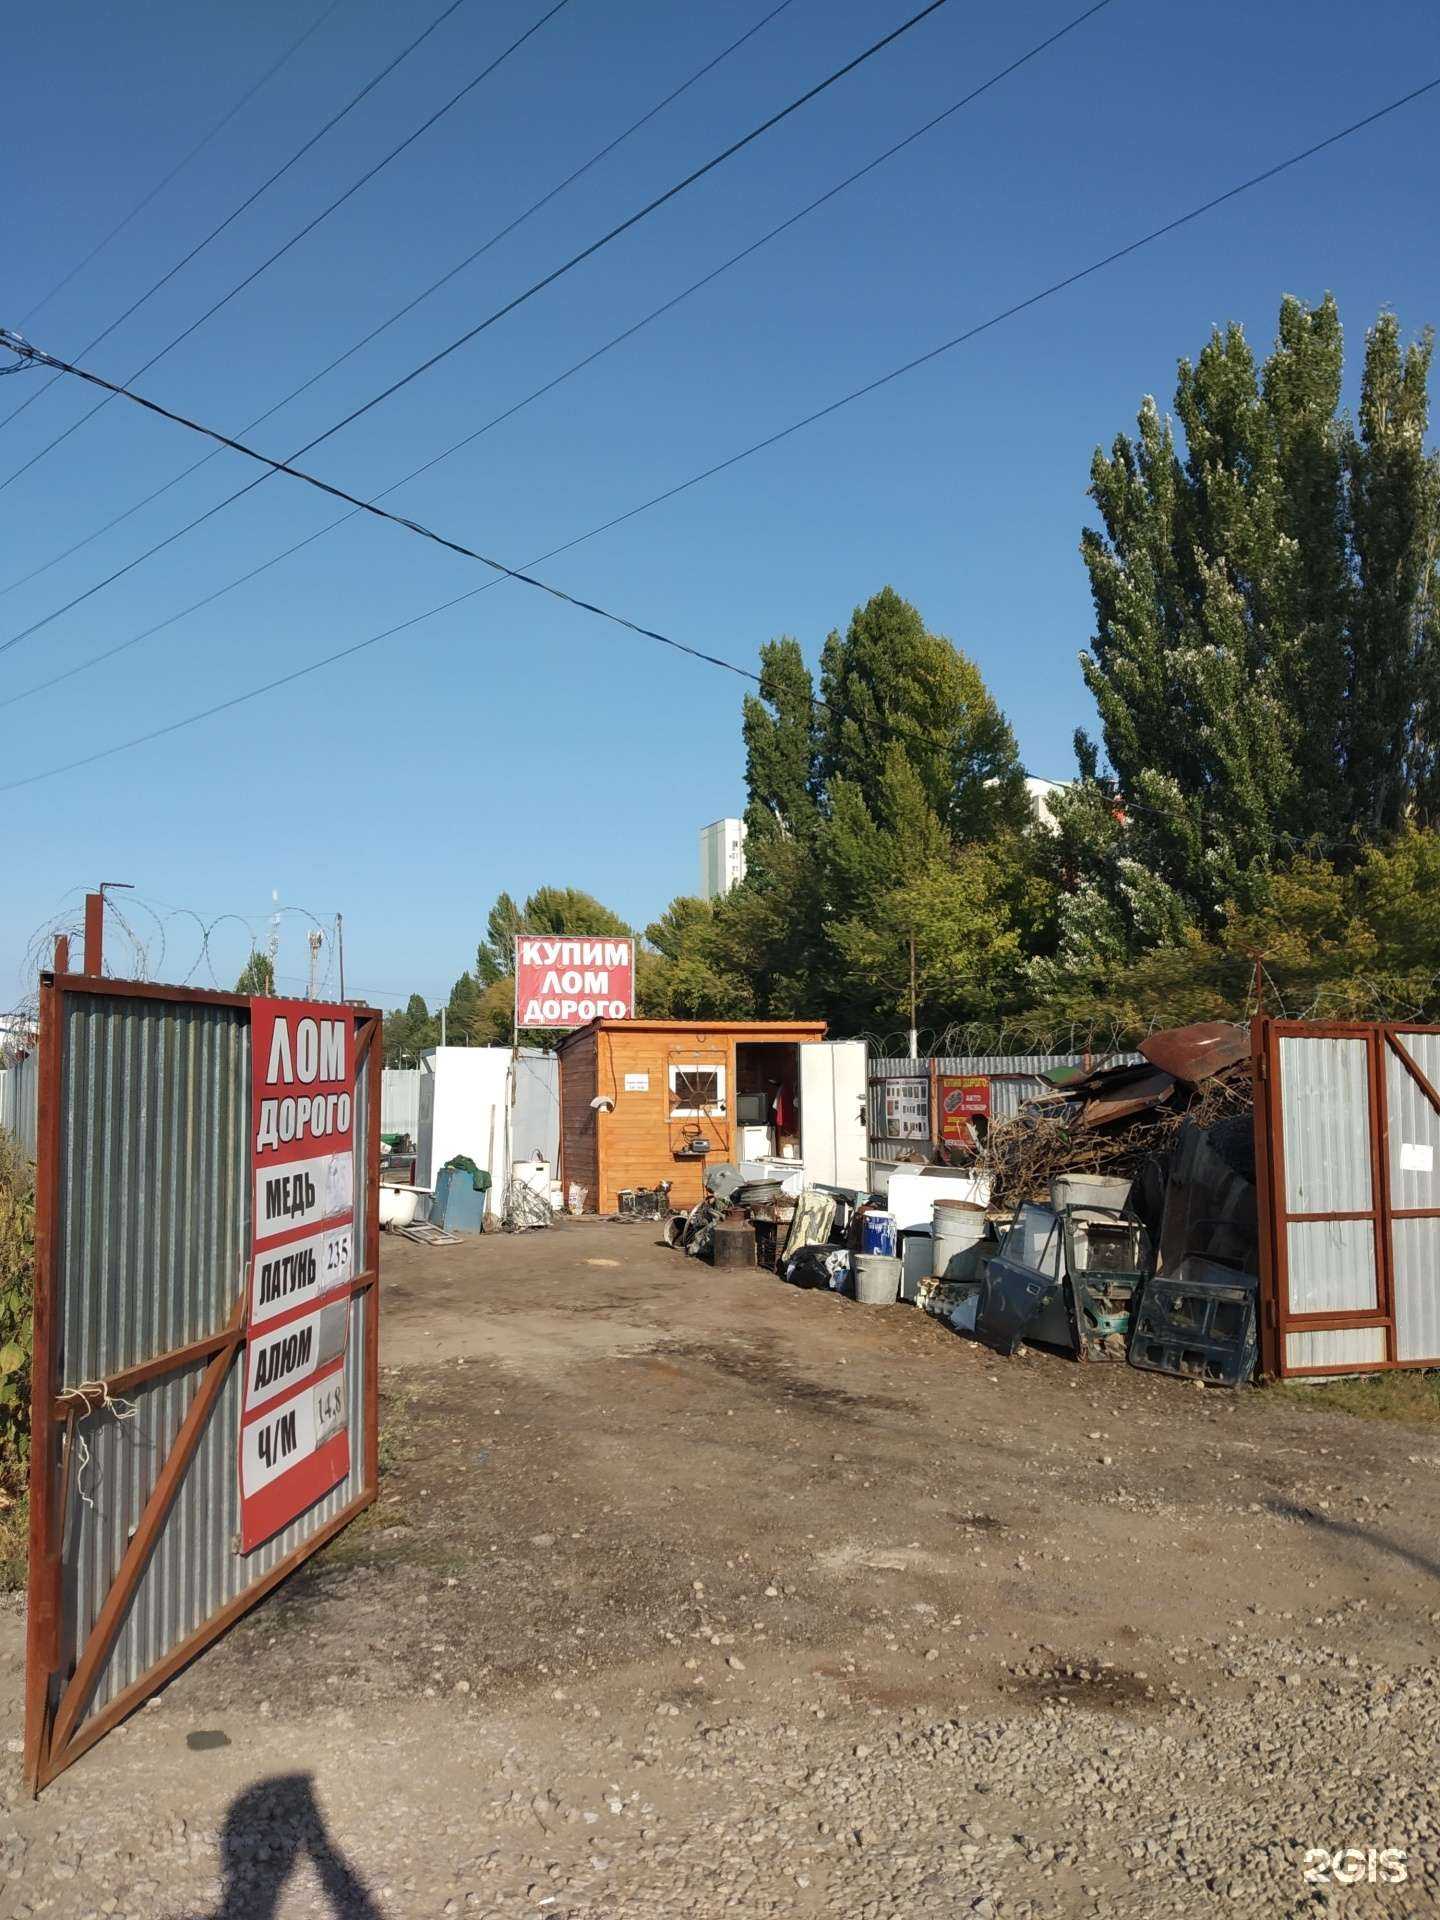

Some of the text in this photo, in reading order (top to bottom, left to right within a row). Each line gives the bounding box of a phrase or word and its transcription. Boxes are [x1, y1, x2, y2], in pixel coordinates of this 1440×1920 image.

[523, 942, 628, 966] КУПИМ
[541, 971, 608, 994] ЛОМ
[524, 1000, 627, 1024] ДОРОГО
[266, 1016, 345, 1084] ЛОМ
[256, 1091, 351, 1153] ДОРОГО
[266, 1172, 316, 1220] МЕДЬ
[259, 1238, 348, 1306] ЛАТУНЬ 235
[254, 1326, 313, 1392] АЛЮМ
[258, 1409, 297, 1468] Ч/М
